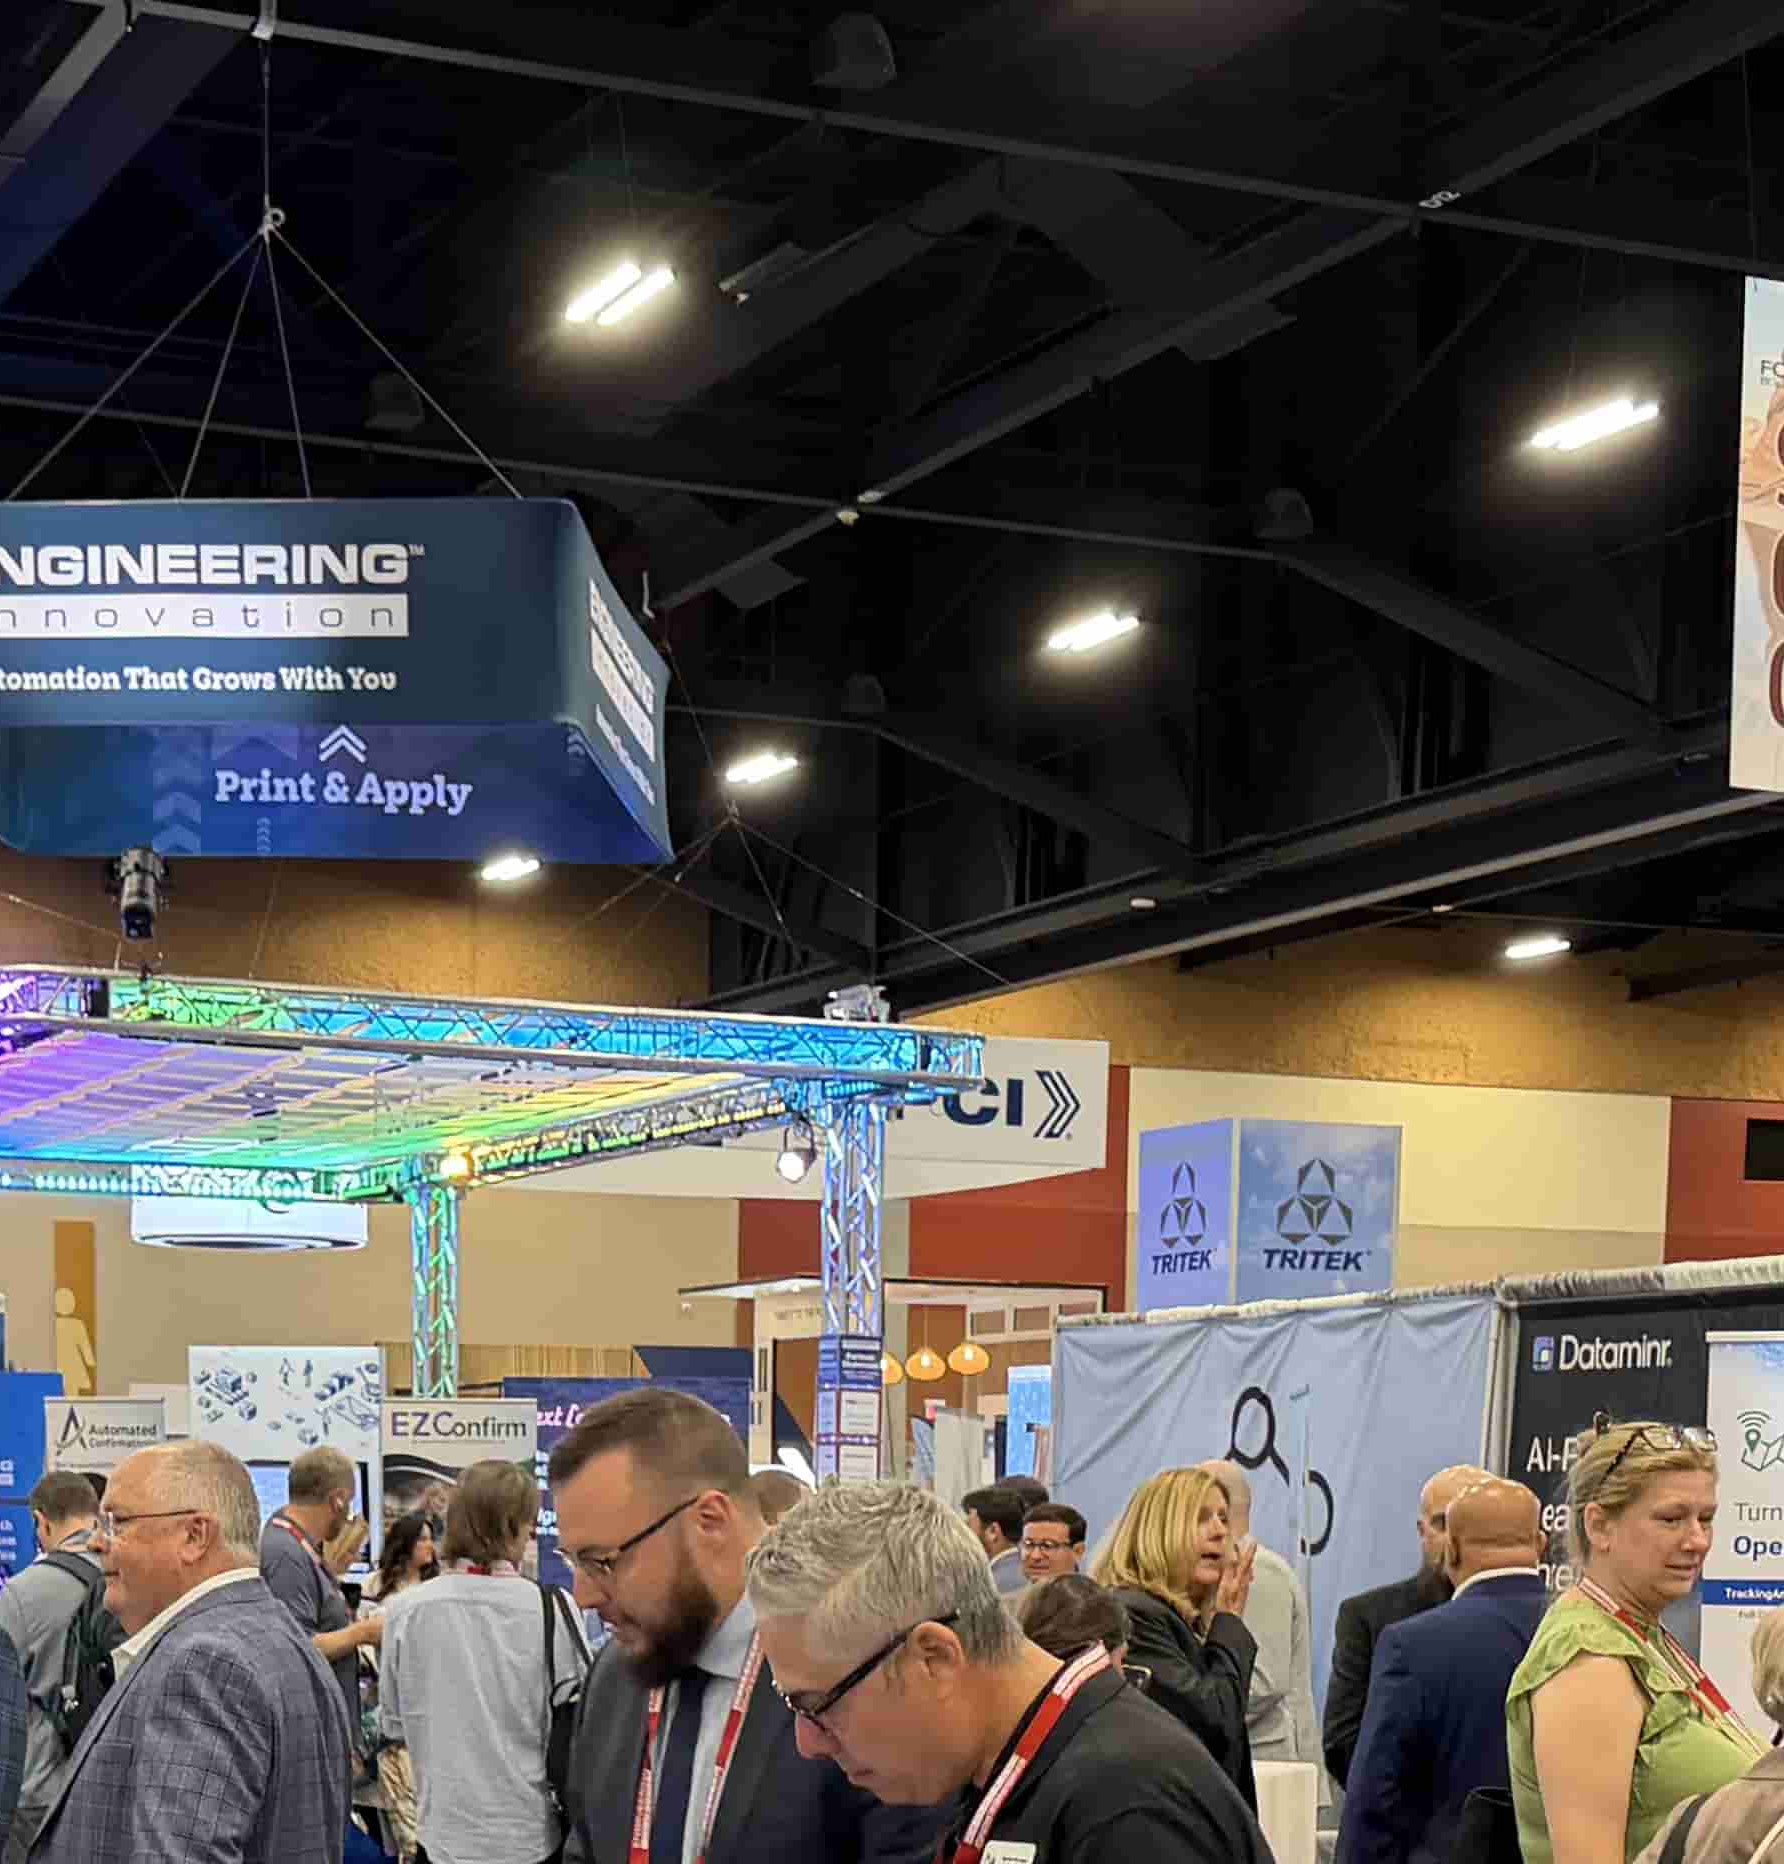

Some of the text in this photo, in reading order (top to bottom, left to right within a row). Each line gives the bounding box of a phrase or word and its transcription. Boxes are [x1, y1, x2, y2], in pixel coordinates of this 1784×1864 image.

[123, 666, 189, 692] That
[192, 666, 276, 692] Grows
[279, 666, 344, 692] With
[346, 666, 397, 692] You
[215, 768, 472, 816] Print & Apply
[896, 1077, 1025, 1127] CI
[1150, 1248, 1213, 1277] TRITEK
[1262, 1248, 1364, 1272] TRITEK
[88, 1424, 158, 1436] Automated
[391, 1410, 527, 1439] EZConfirm
[1733, 1503, 1783, 1523] Turn
